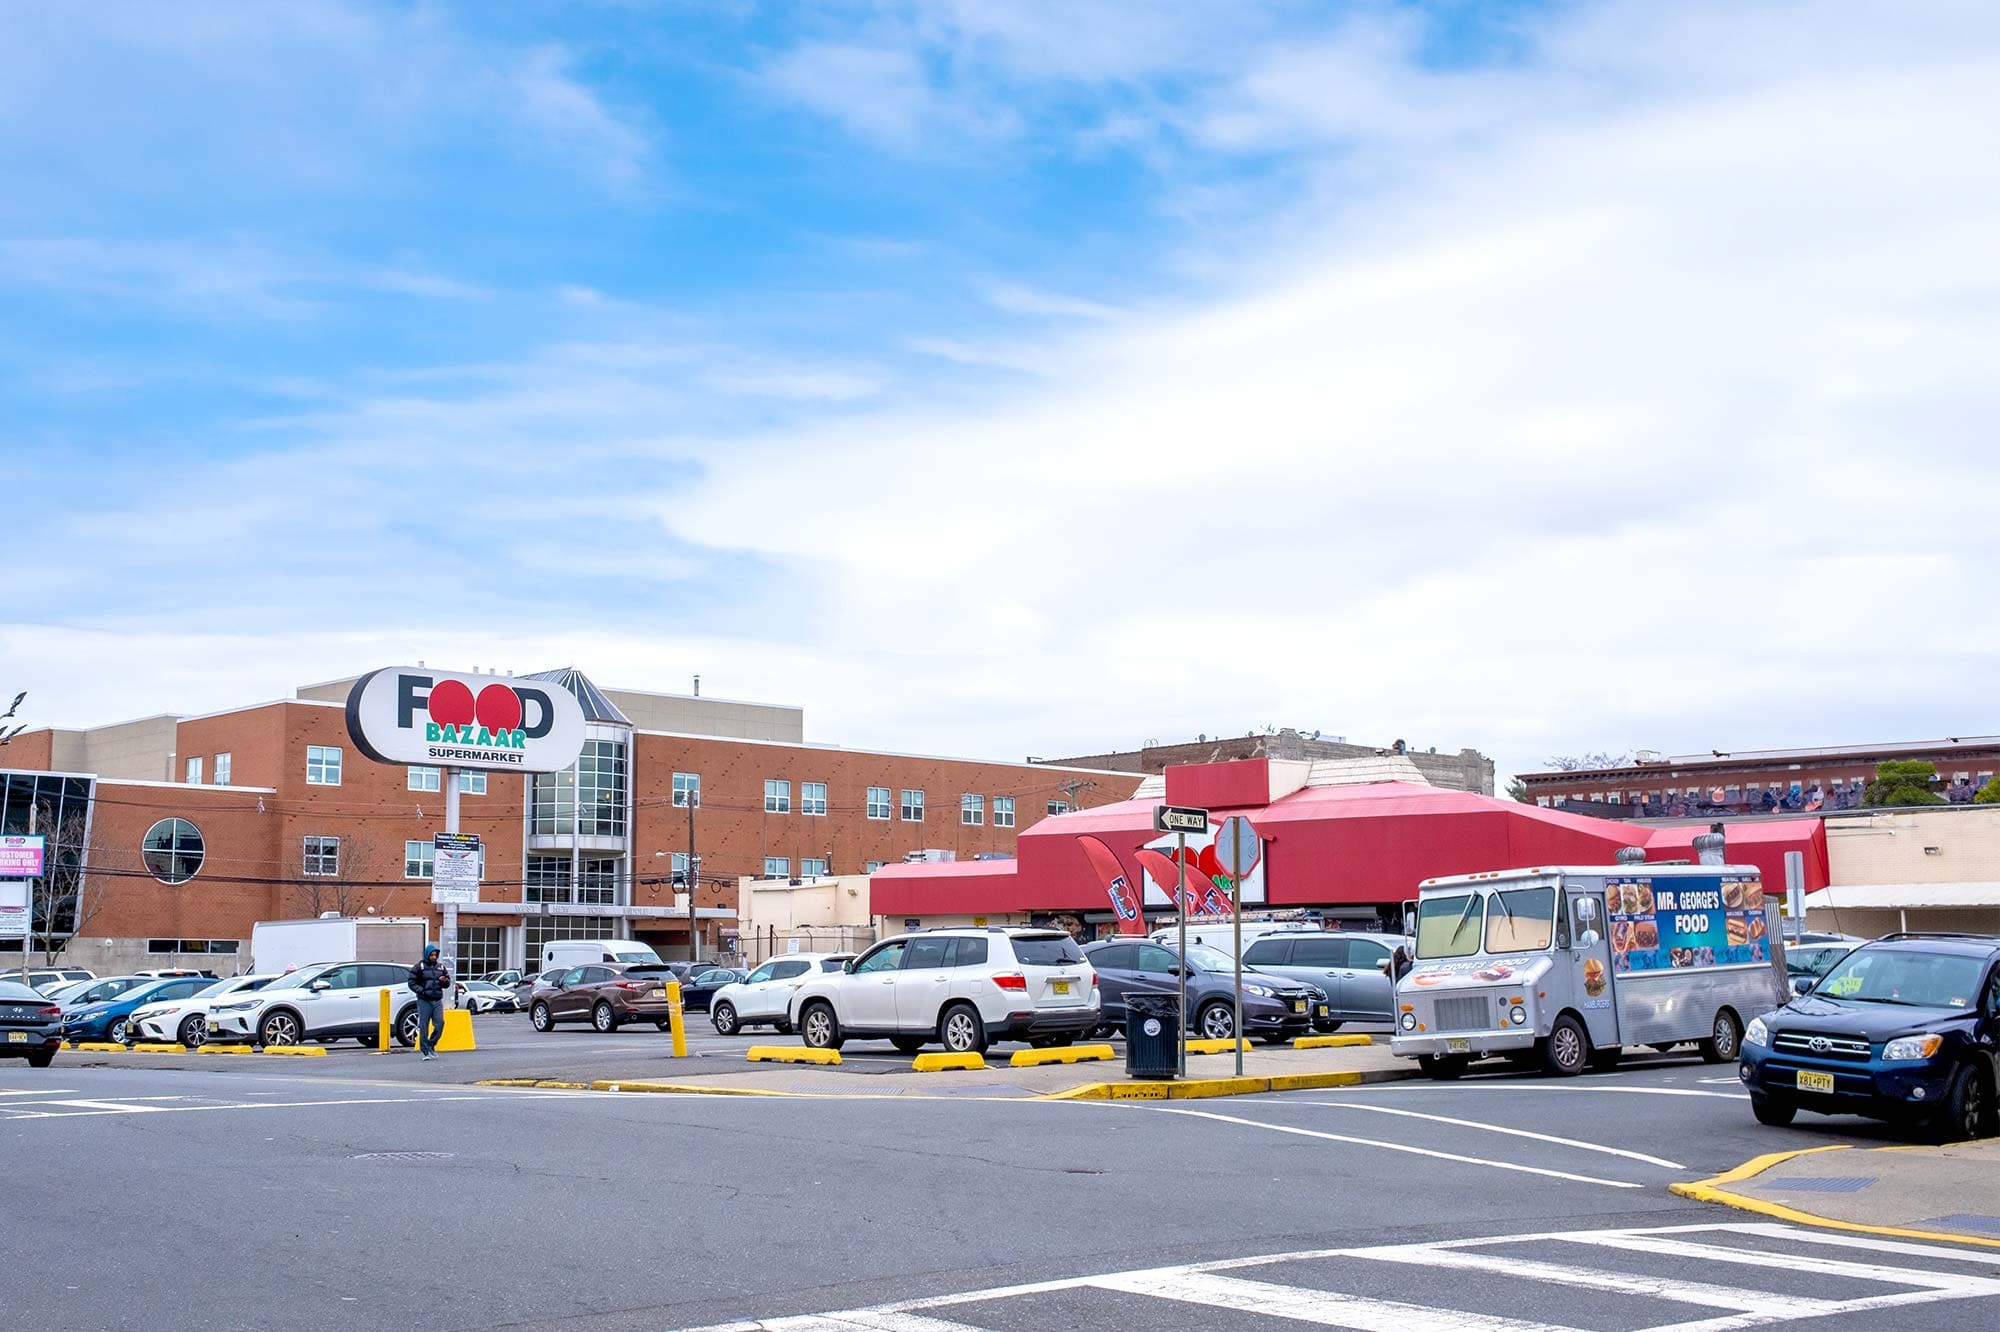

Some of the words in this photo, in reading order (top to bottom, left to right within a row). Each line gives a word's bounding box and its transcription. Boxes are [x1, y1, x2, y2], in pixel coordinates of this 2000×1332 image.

[398, 674, 554, 739] FOOD
[426, 722, 527, 749] BAZAAR
[429, 748, 524, 763] SUPERMARKET
[1169, 814, 1183, 825] ONE
[1187, 815, 1202, 826] WAY
[1657, 892, 1677, 910] MR.
[1680, 891, 1720, 909] GEORGE'S
[1675, 914, 1709, 933] FOOD
[1490, 958, 1529, 967] FOOD
